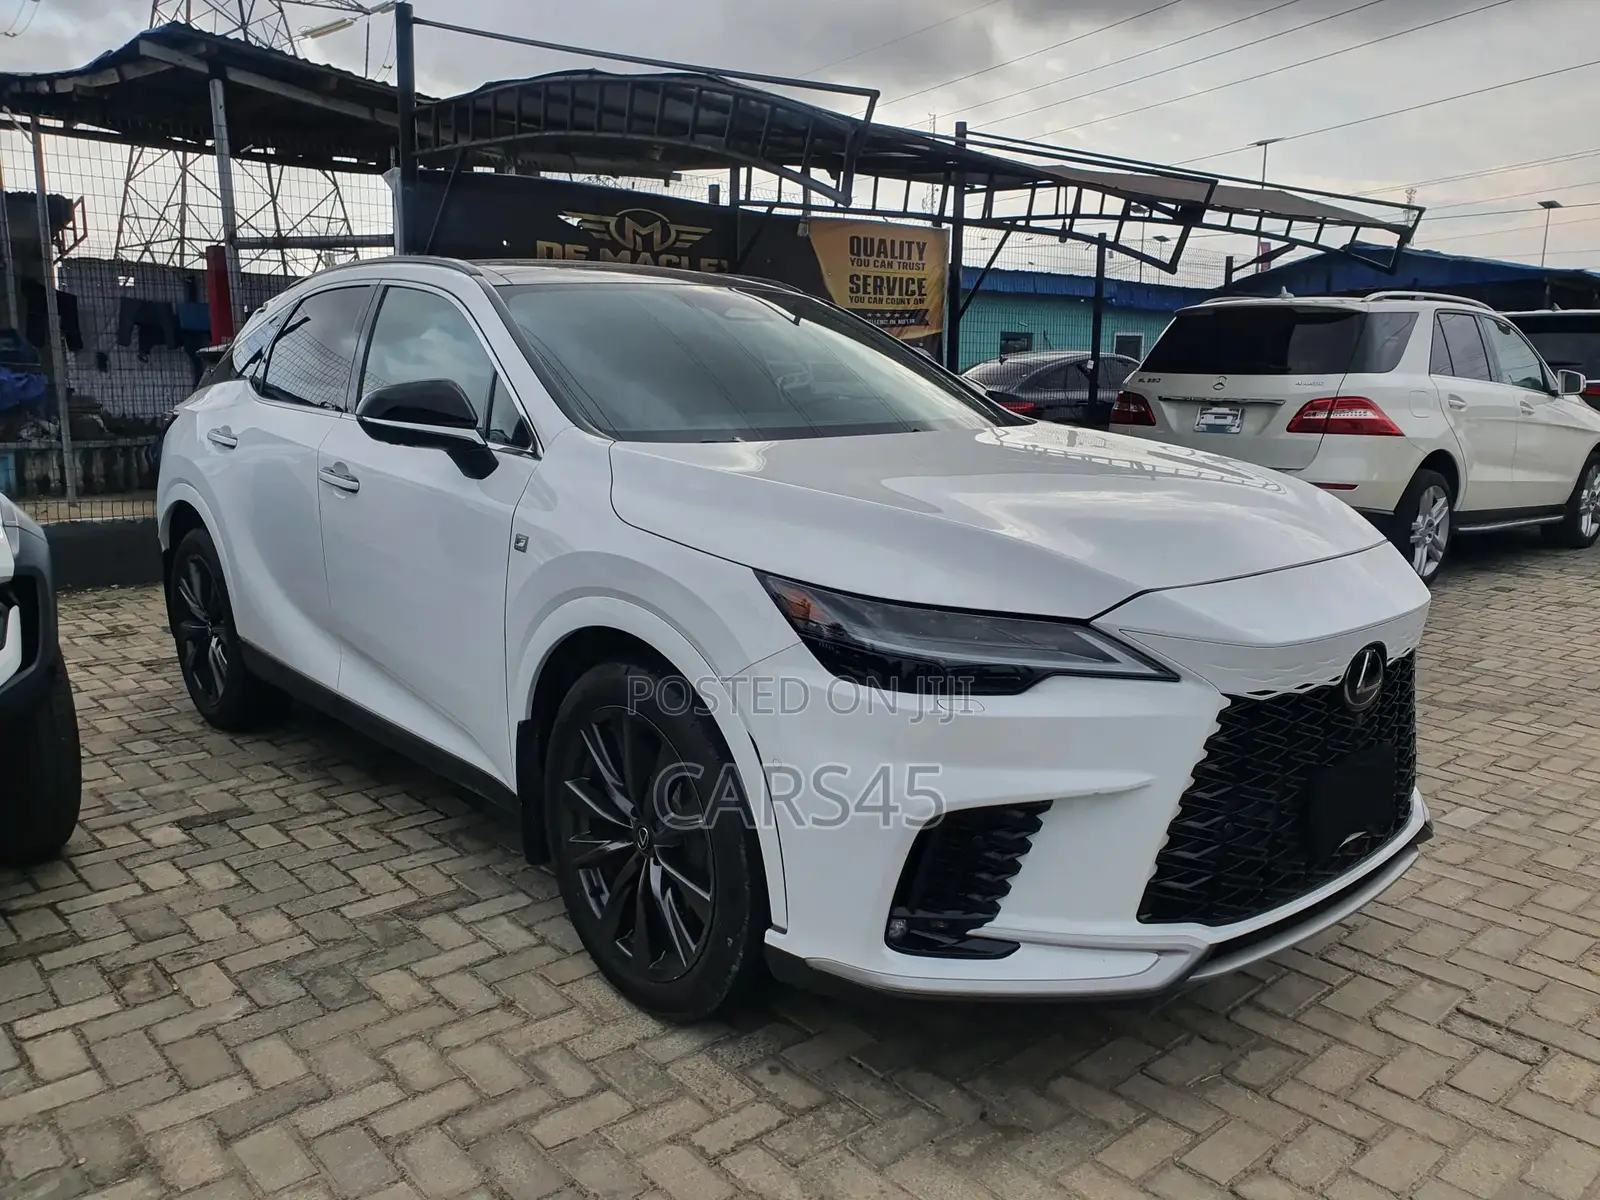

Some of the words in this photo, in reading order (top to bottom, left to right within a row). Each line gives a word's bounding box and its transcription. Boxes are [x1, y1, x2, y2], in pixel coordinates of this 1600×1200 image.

[849, 235, 928, 261] QUALITY
[849, 257, 870, 268] YOU
[873, 259, 893, 269] CAN
[897, 261, 926, 271] TRUST
[849, 273, 928, 297] SERVICE
[849, 295, 865, 304] YOU
[867, 296, 884, 305] CAN
[885, 297, 911, 306] COUNT
[913, 298, 925, 306] ON
